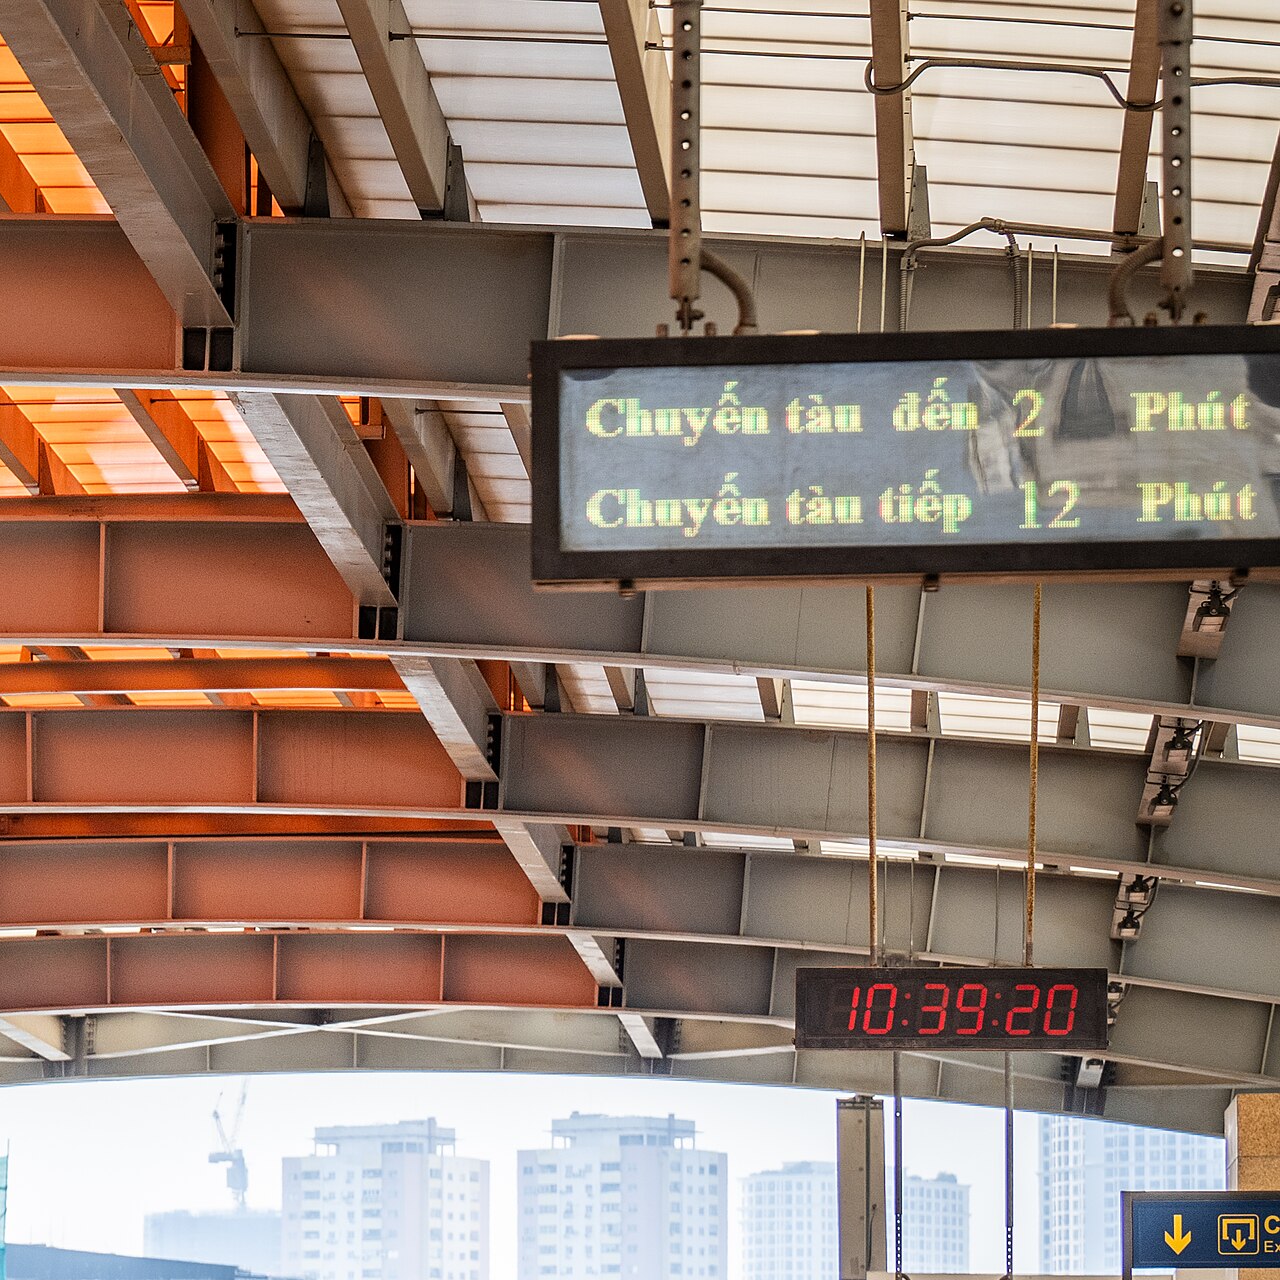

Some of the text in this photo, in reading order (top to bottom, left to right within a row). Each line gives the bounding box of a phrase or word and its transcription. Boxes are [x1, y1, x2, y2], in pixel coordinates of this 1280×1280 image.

[585, 377, 1252, 447] Chuyến tàu đến 2 Phút
[585, 469, 1258, 538] Chuyến tàu tiếp 12 Phút
[848, 983, 1080, 1037] 10:39:20
[1264, 1240, 1280, 1253] Ex
